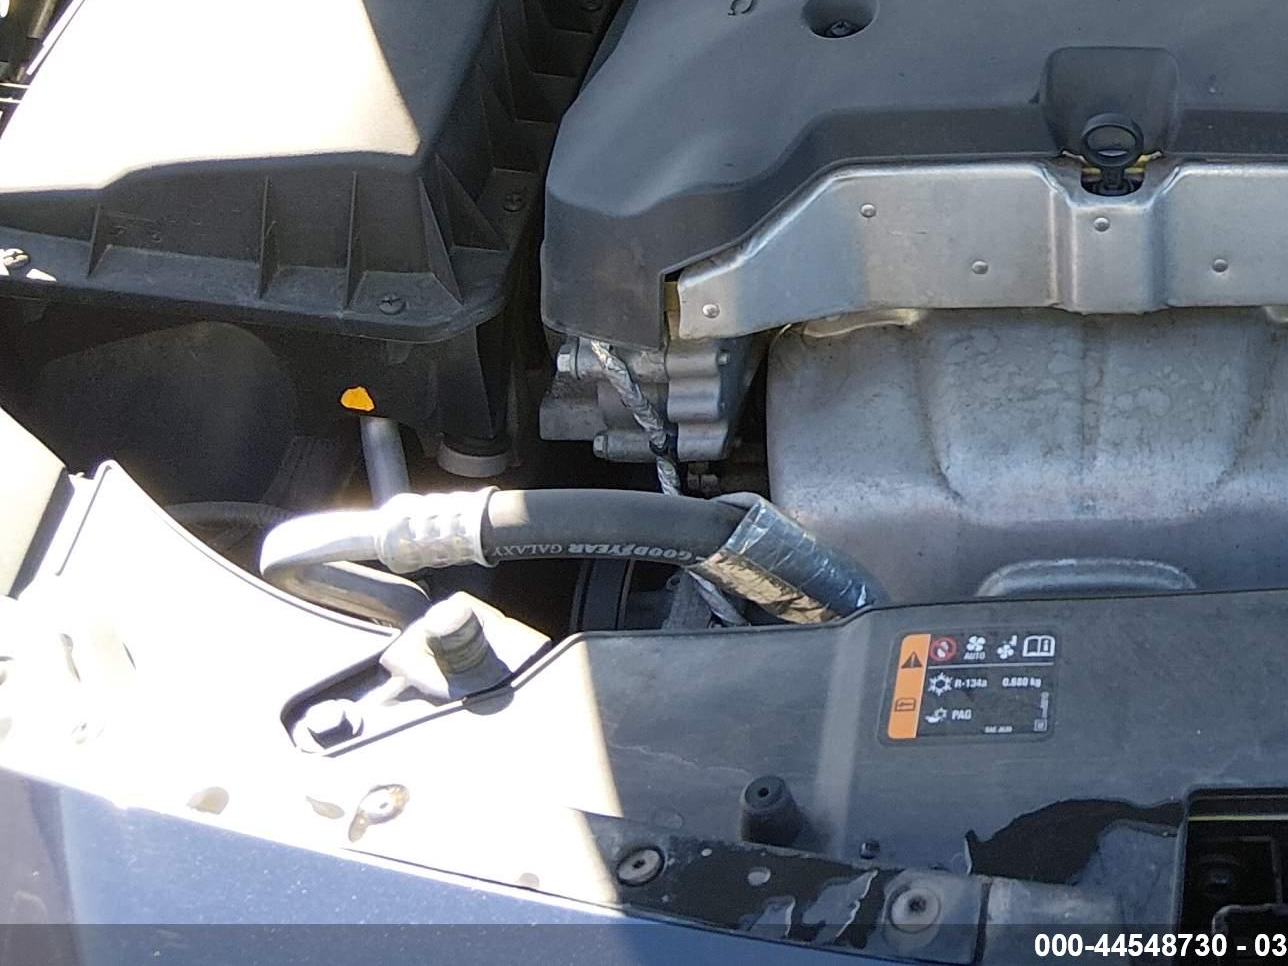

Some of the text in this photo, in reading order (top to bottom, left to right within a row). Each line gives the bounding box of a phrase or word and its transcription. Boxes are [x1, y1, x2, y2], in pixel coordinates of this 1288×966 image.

[491, 542, 692, 562] GOODYEAR GALAXY
[963, 652, 986, 661] AUTO
[954, 678, 987, 689] R-134a
[952, 709, 972, 720] PAG
